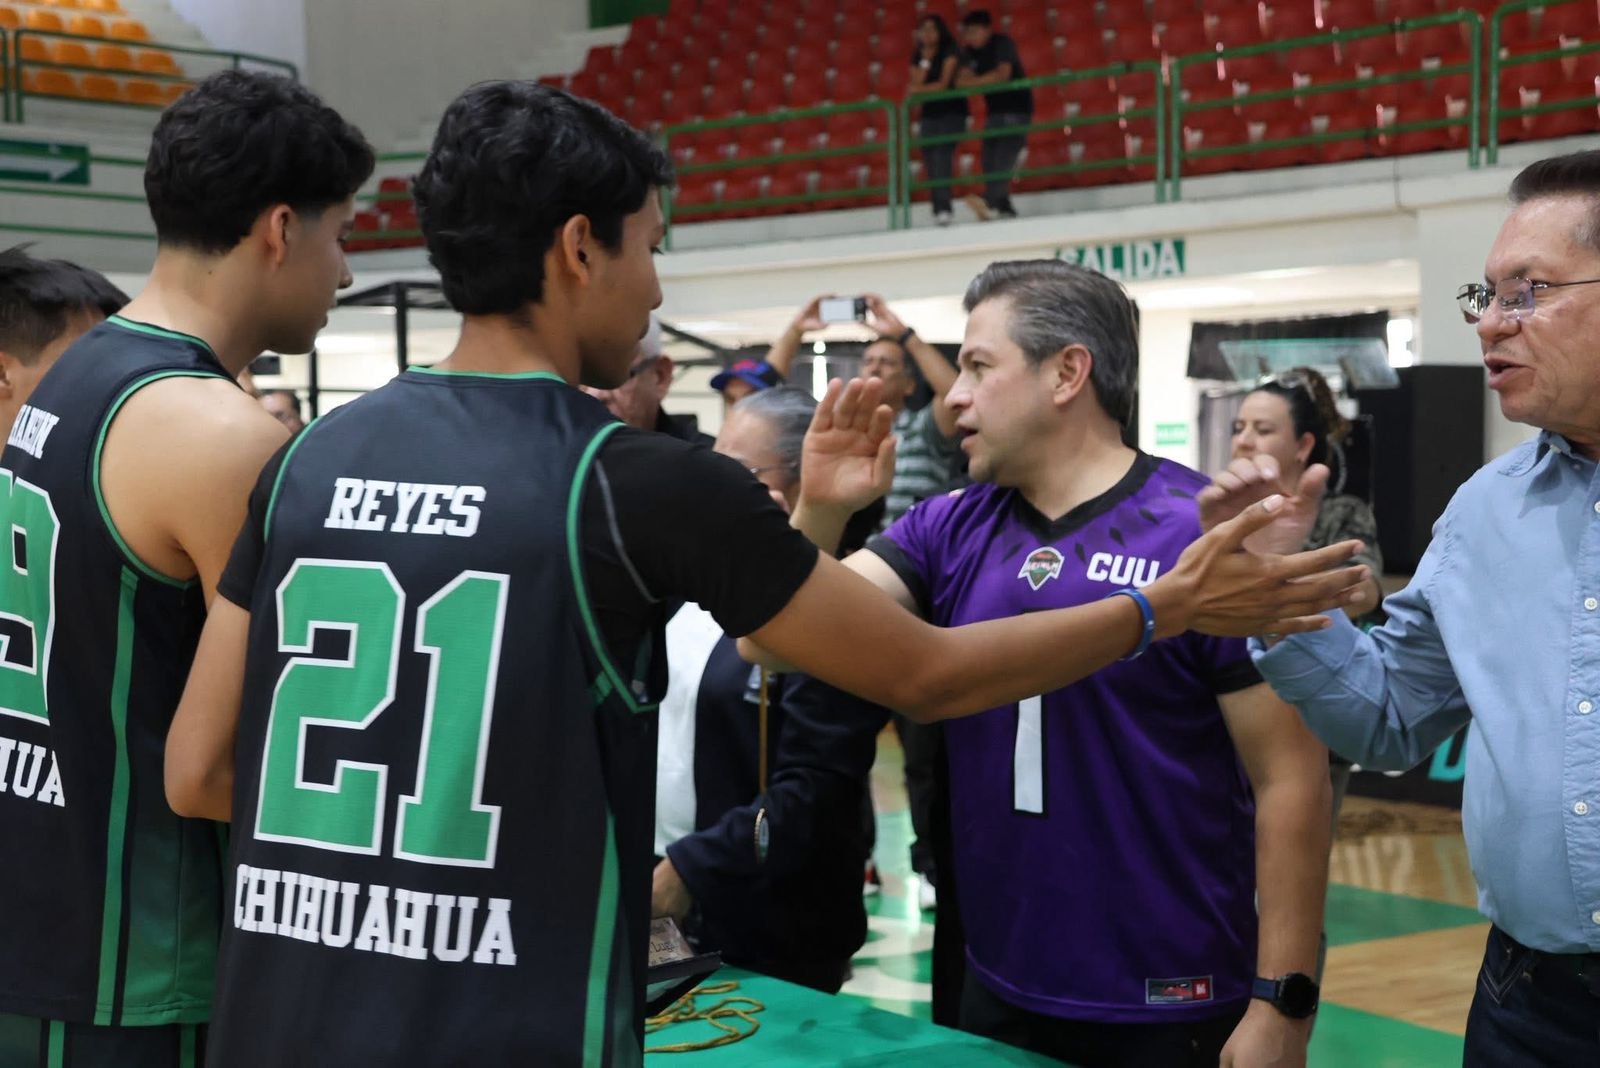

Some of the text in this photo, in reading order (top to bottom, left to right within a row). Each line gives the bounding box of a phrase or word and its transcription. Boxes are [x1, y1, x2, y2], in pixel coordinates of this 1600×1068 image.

[323, 477, 486, 538] REYES
[1086, 551, 1160, 588] CUU
[253, 557, 510, 869] 21
[234, 863, 517, 966] CHIHUAHUA
